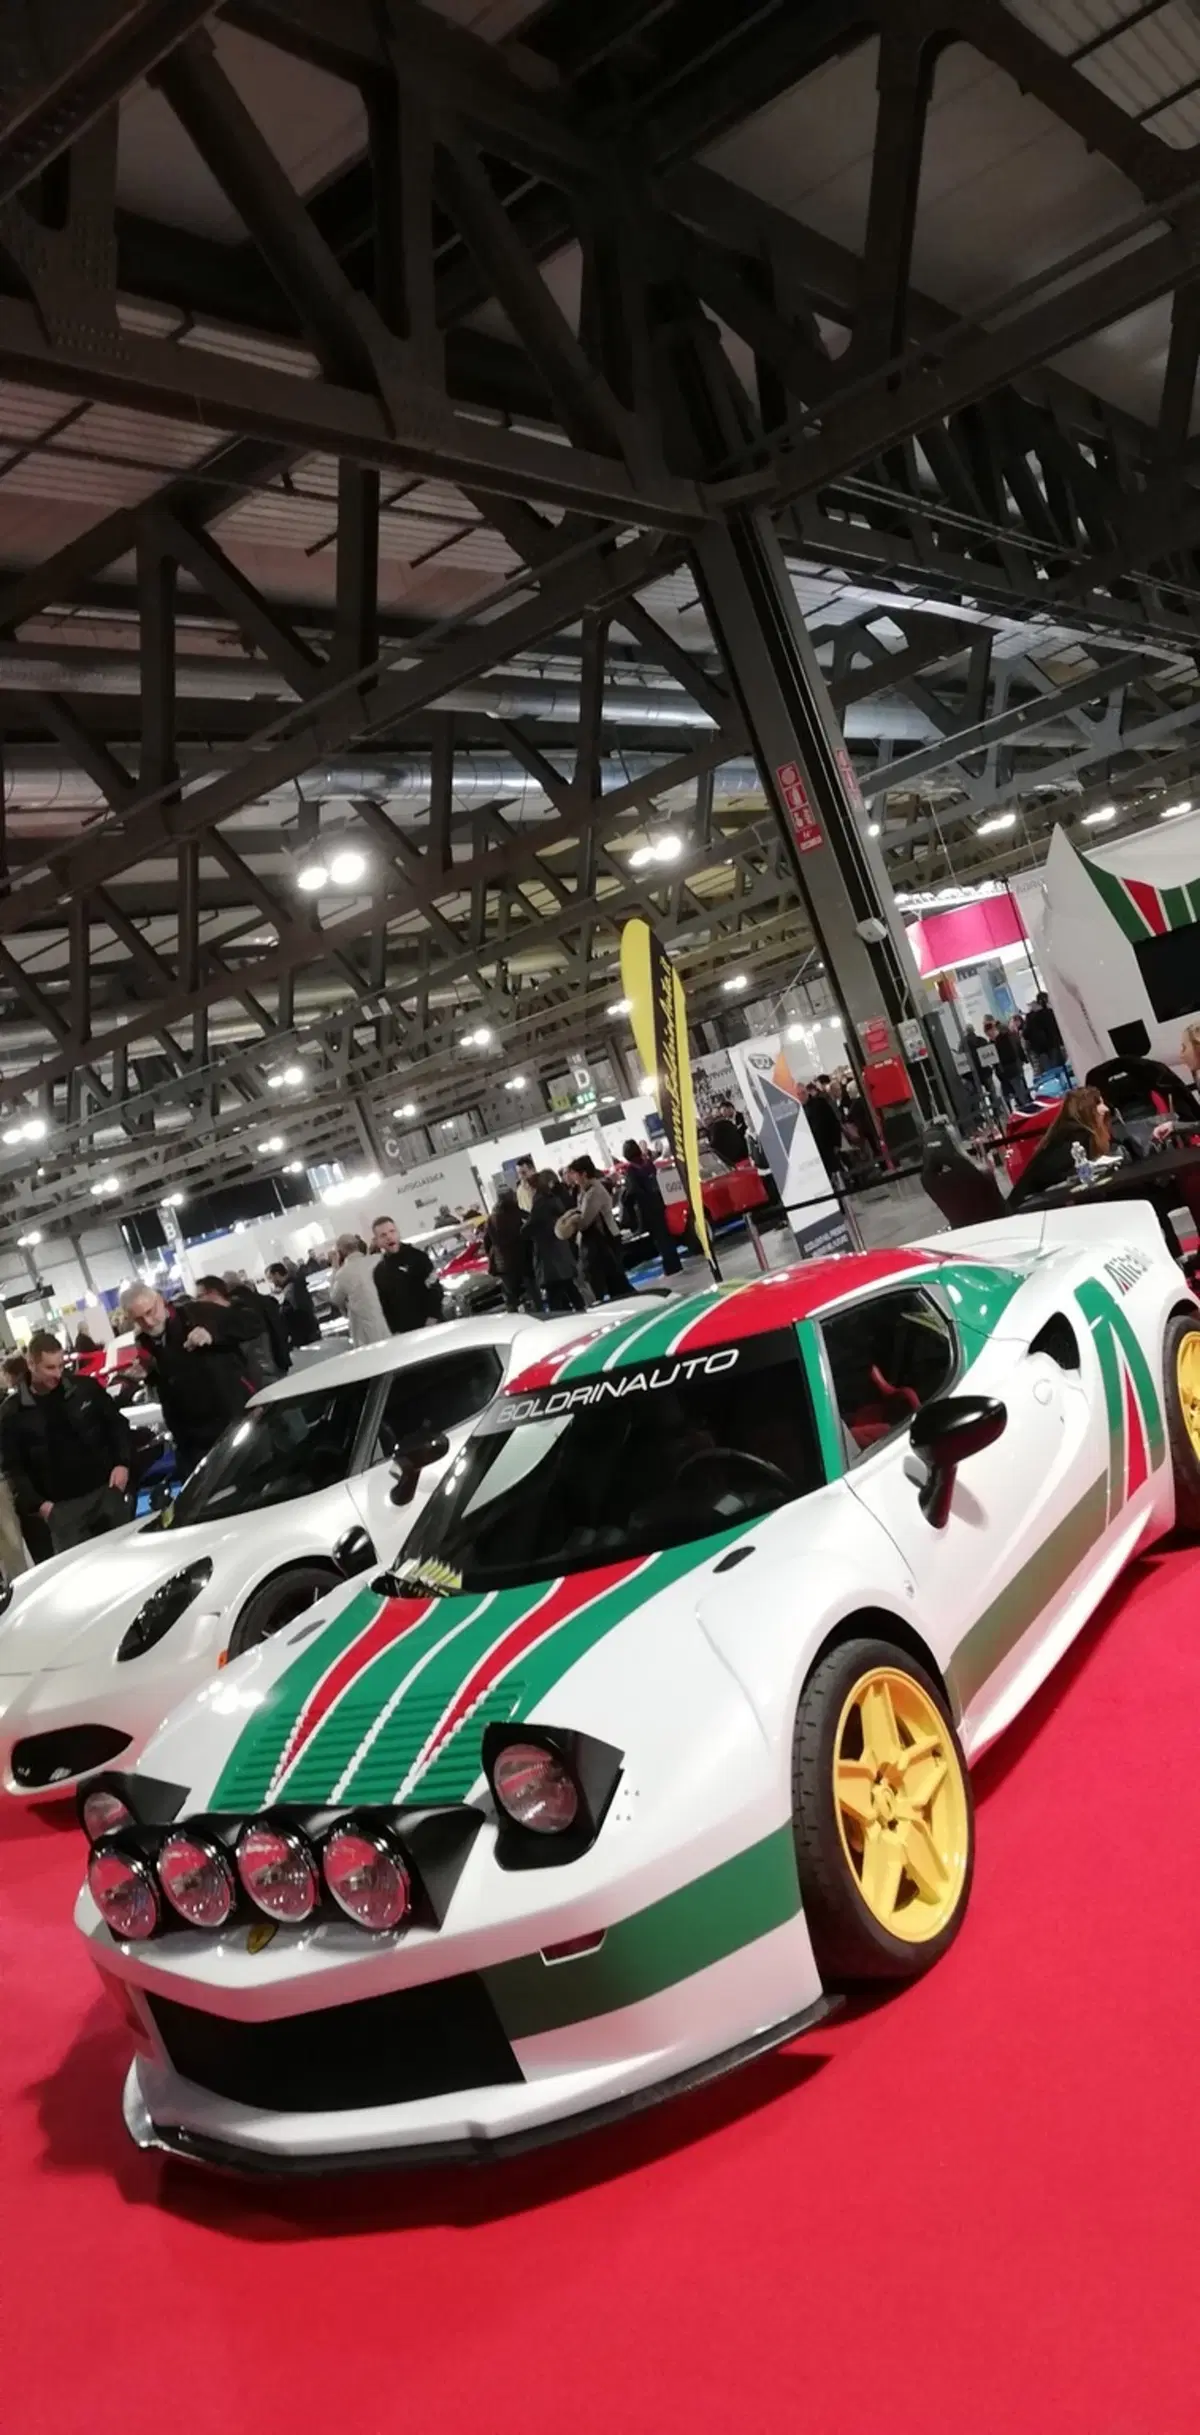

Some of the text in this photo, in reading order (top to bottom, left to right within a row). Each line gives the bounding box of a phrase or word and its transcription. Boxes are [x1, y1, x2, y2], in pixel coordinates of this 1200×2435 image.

[573, 1068, 591, 1090] D
[384, 1138, 400, 1158] C
[163, 1222, 177, 1242] B
[495, 1348, 740, 1424] BOLDRINAUTO
